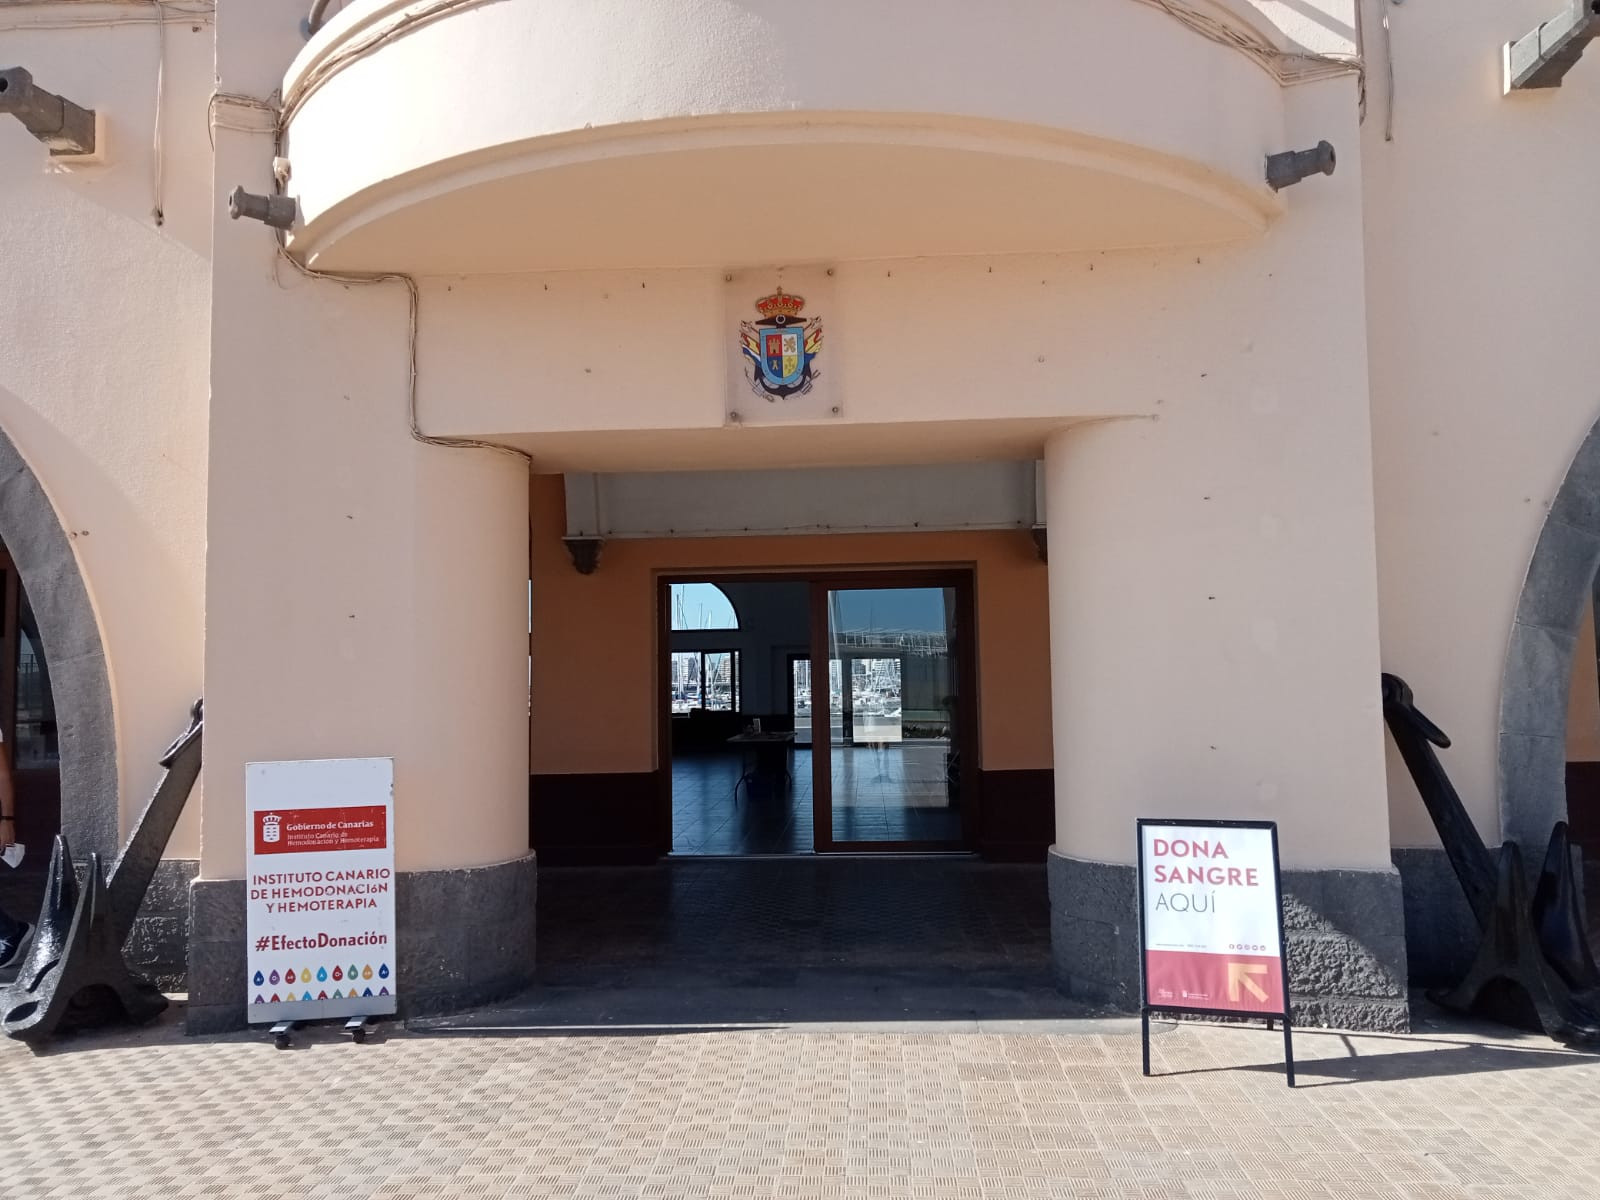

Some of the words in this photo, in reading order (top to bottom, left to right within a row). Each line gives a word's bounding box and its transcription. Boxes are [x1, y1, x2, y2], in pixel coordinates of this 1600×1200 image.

[286, 823, 326, 831] Gobierno
[337, 820, 374, 829] Canarias
[1153, 839, 1229, 859] DONA
[253, 872, 323, 886] INSTITUTO
[325, 868, 391, 882] CANARIO
[1154, 864, 1260, 887] SANGRE
[250, 889, 268, 900] DE
[1155, 890, 1216, 913] AQUÍ
[266, 903, 274, 913] Y
[277, 898, 378, 913] HEMOTERAPIA
[255, 931, 388, 952] #EfectoDonación
